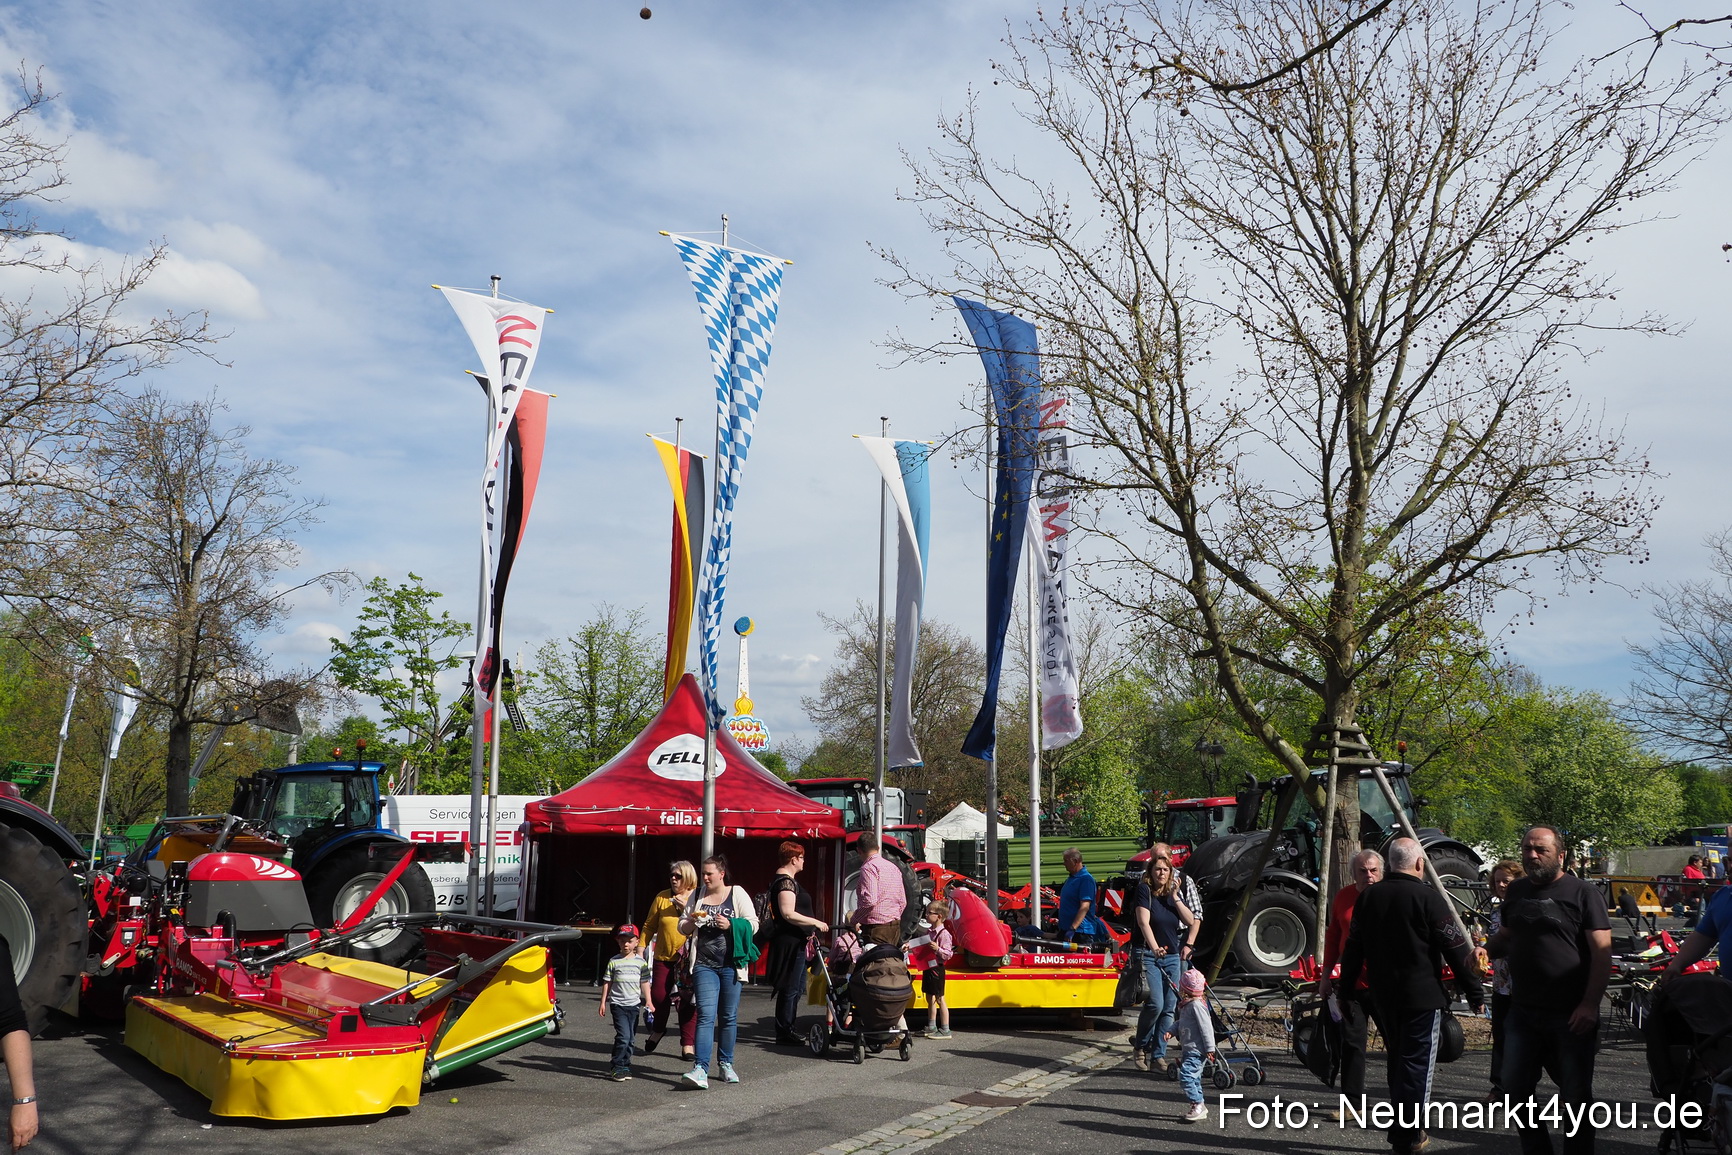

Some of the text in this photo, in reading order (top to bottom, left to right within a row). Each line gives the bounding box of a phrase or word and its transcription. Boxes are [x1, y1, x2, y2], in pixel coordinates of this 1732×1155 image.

[656, 751, 718, 768] FELL
[429, 808, 516, 821] Servicwgen
[660, 811, 703, 826] fella.e
[1034, 956, 1065, 964] RAMOS
